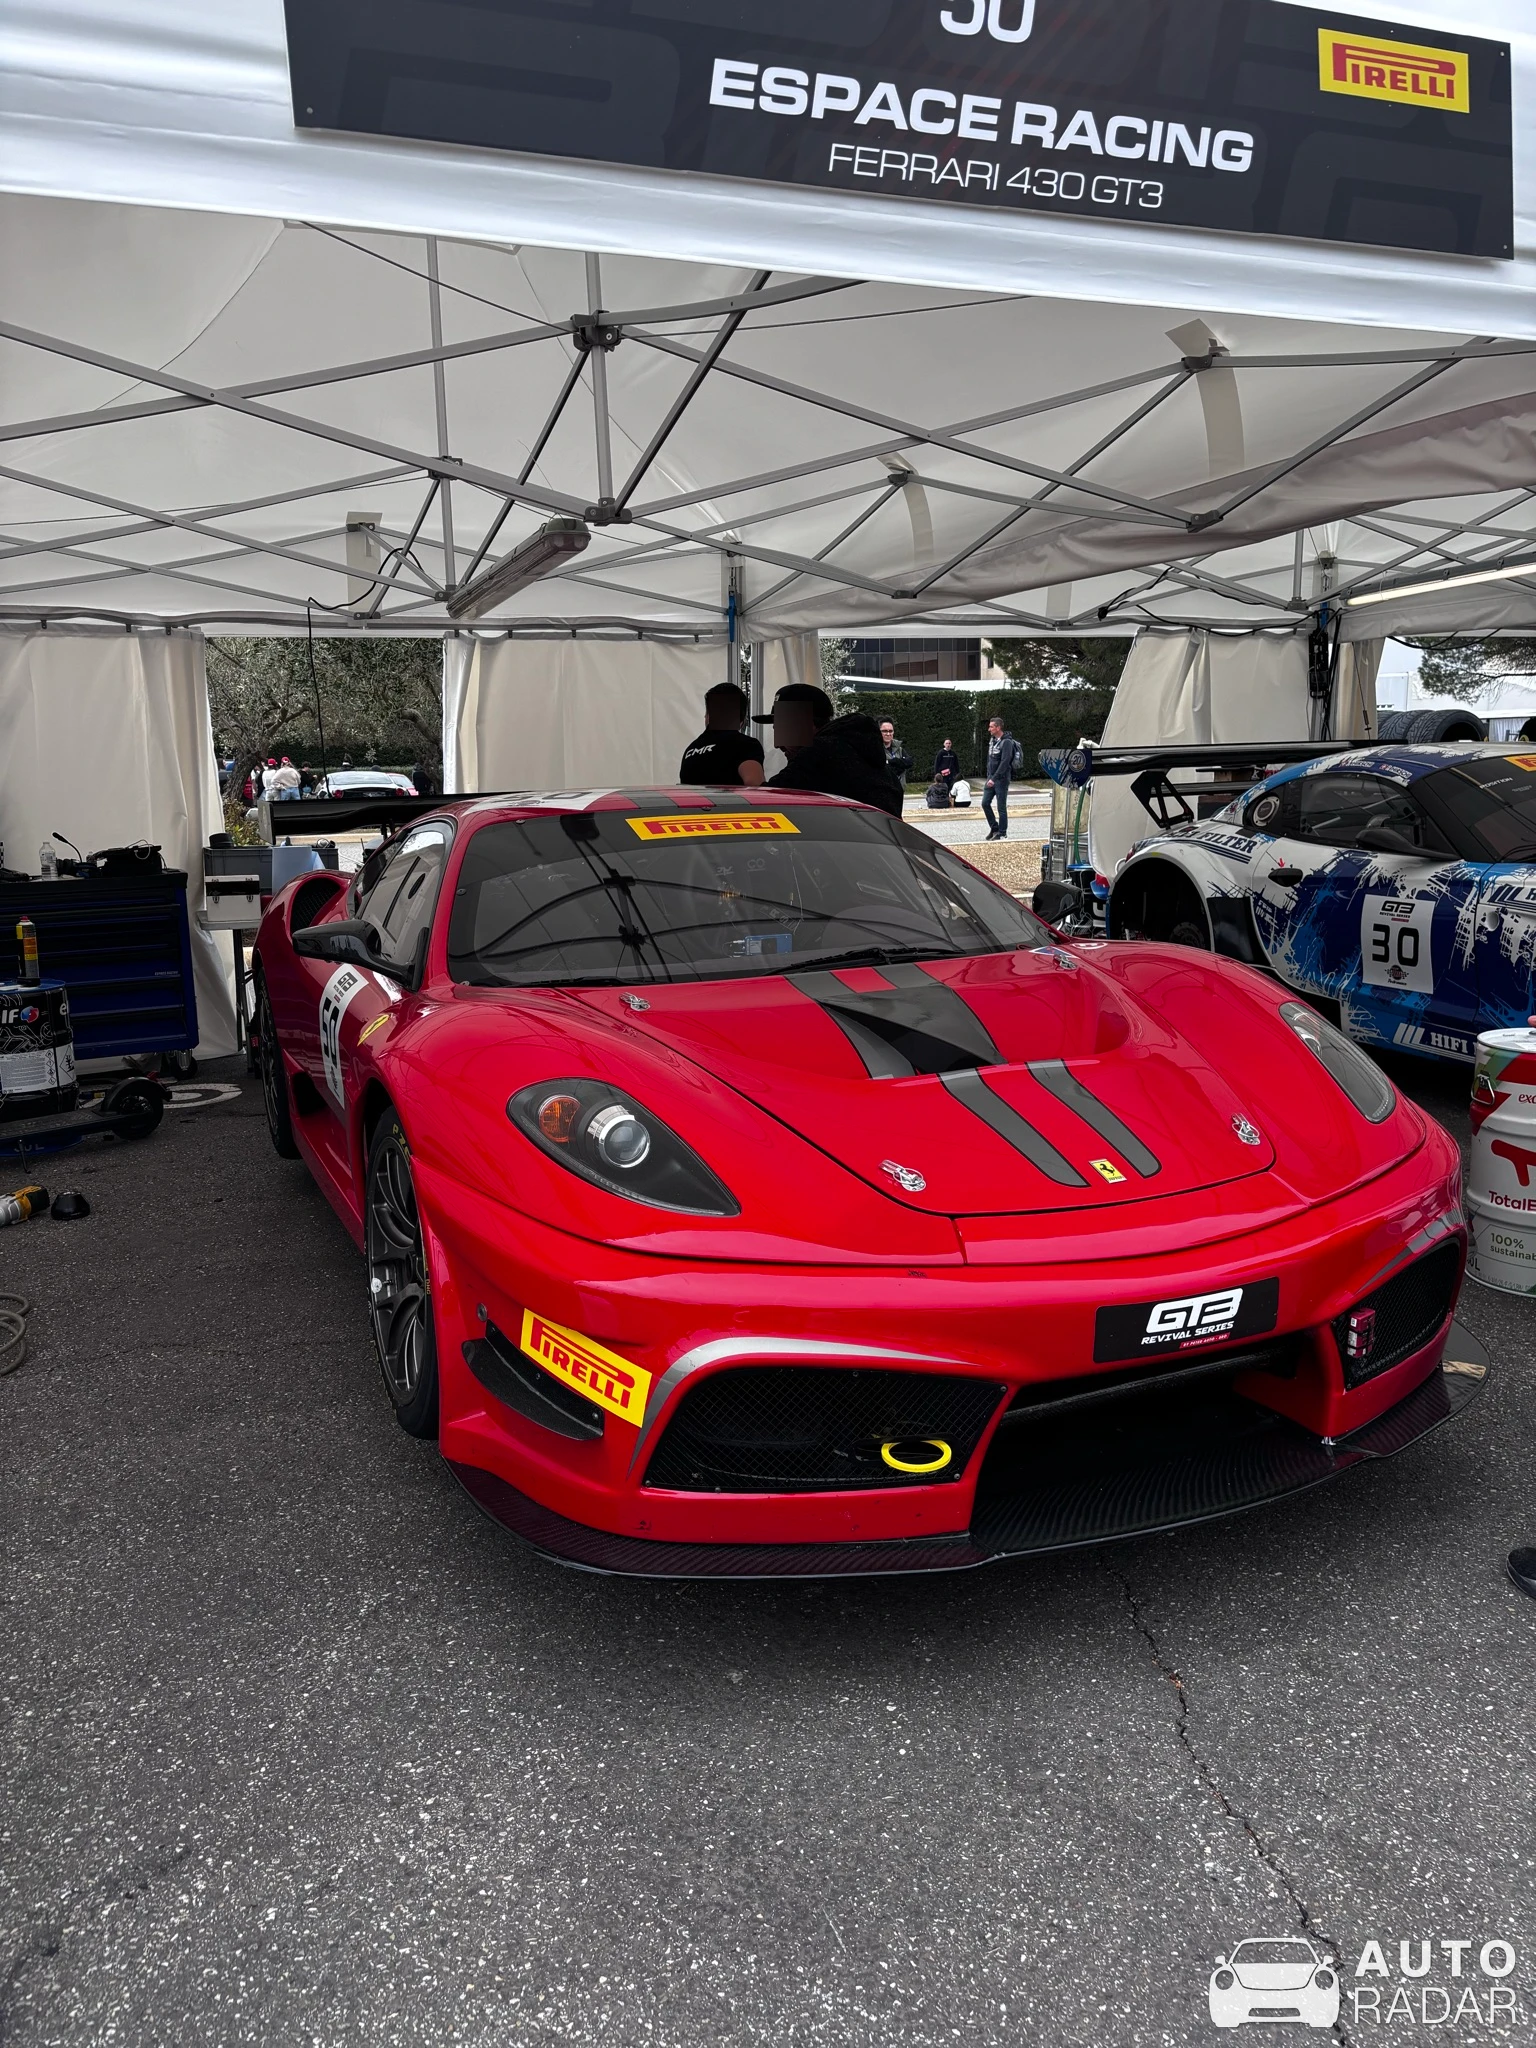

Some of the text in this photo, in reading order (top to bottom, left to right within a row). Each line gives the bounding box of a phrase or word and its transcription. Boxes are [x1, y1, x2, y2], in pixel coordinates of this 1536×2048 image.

[1332, 42, 1456, 99] PIRELLI
[709, 58, 1254, 173] ESPACE RACING
[829, 143, 1163, 208] FERRARI 430 GT3
[643, 816, 782, 835] PIRELLI
[1381, 900, 1416, 914] GT3
[1371, 923, 1420, 967] 30
[1430, 1032, 1468, 1054] HIFI
[1491, 1232, 1524, 1250] 100%
[1146, 1288, 1243, 1333] GT3
[1141, 1321, 1235, 1345] REVIVAL SERIES
[530, 1316, 635, 1409] PIRELLI
